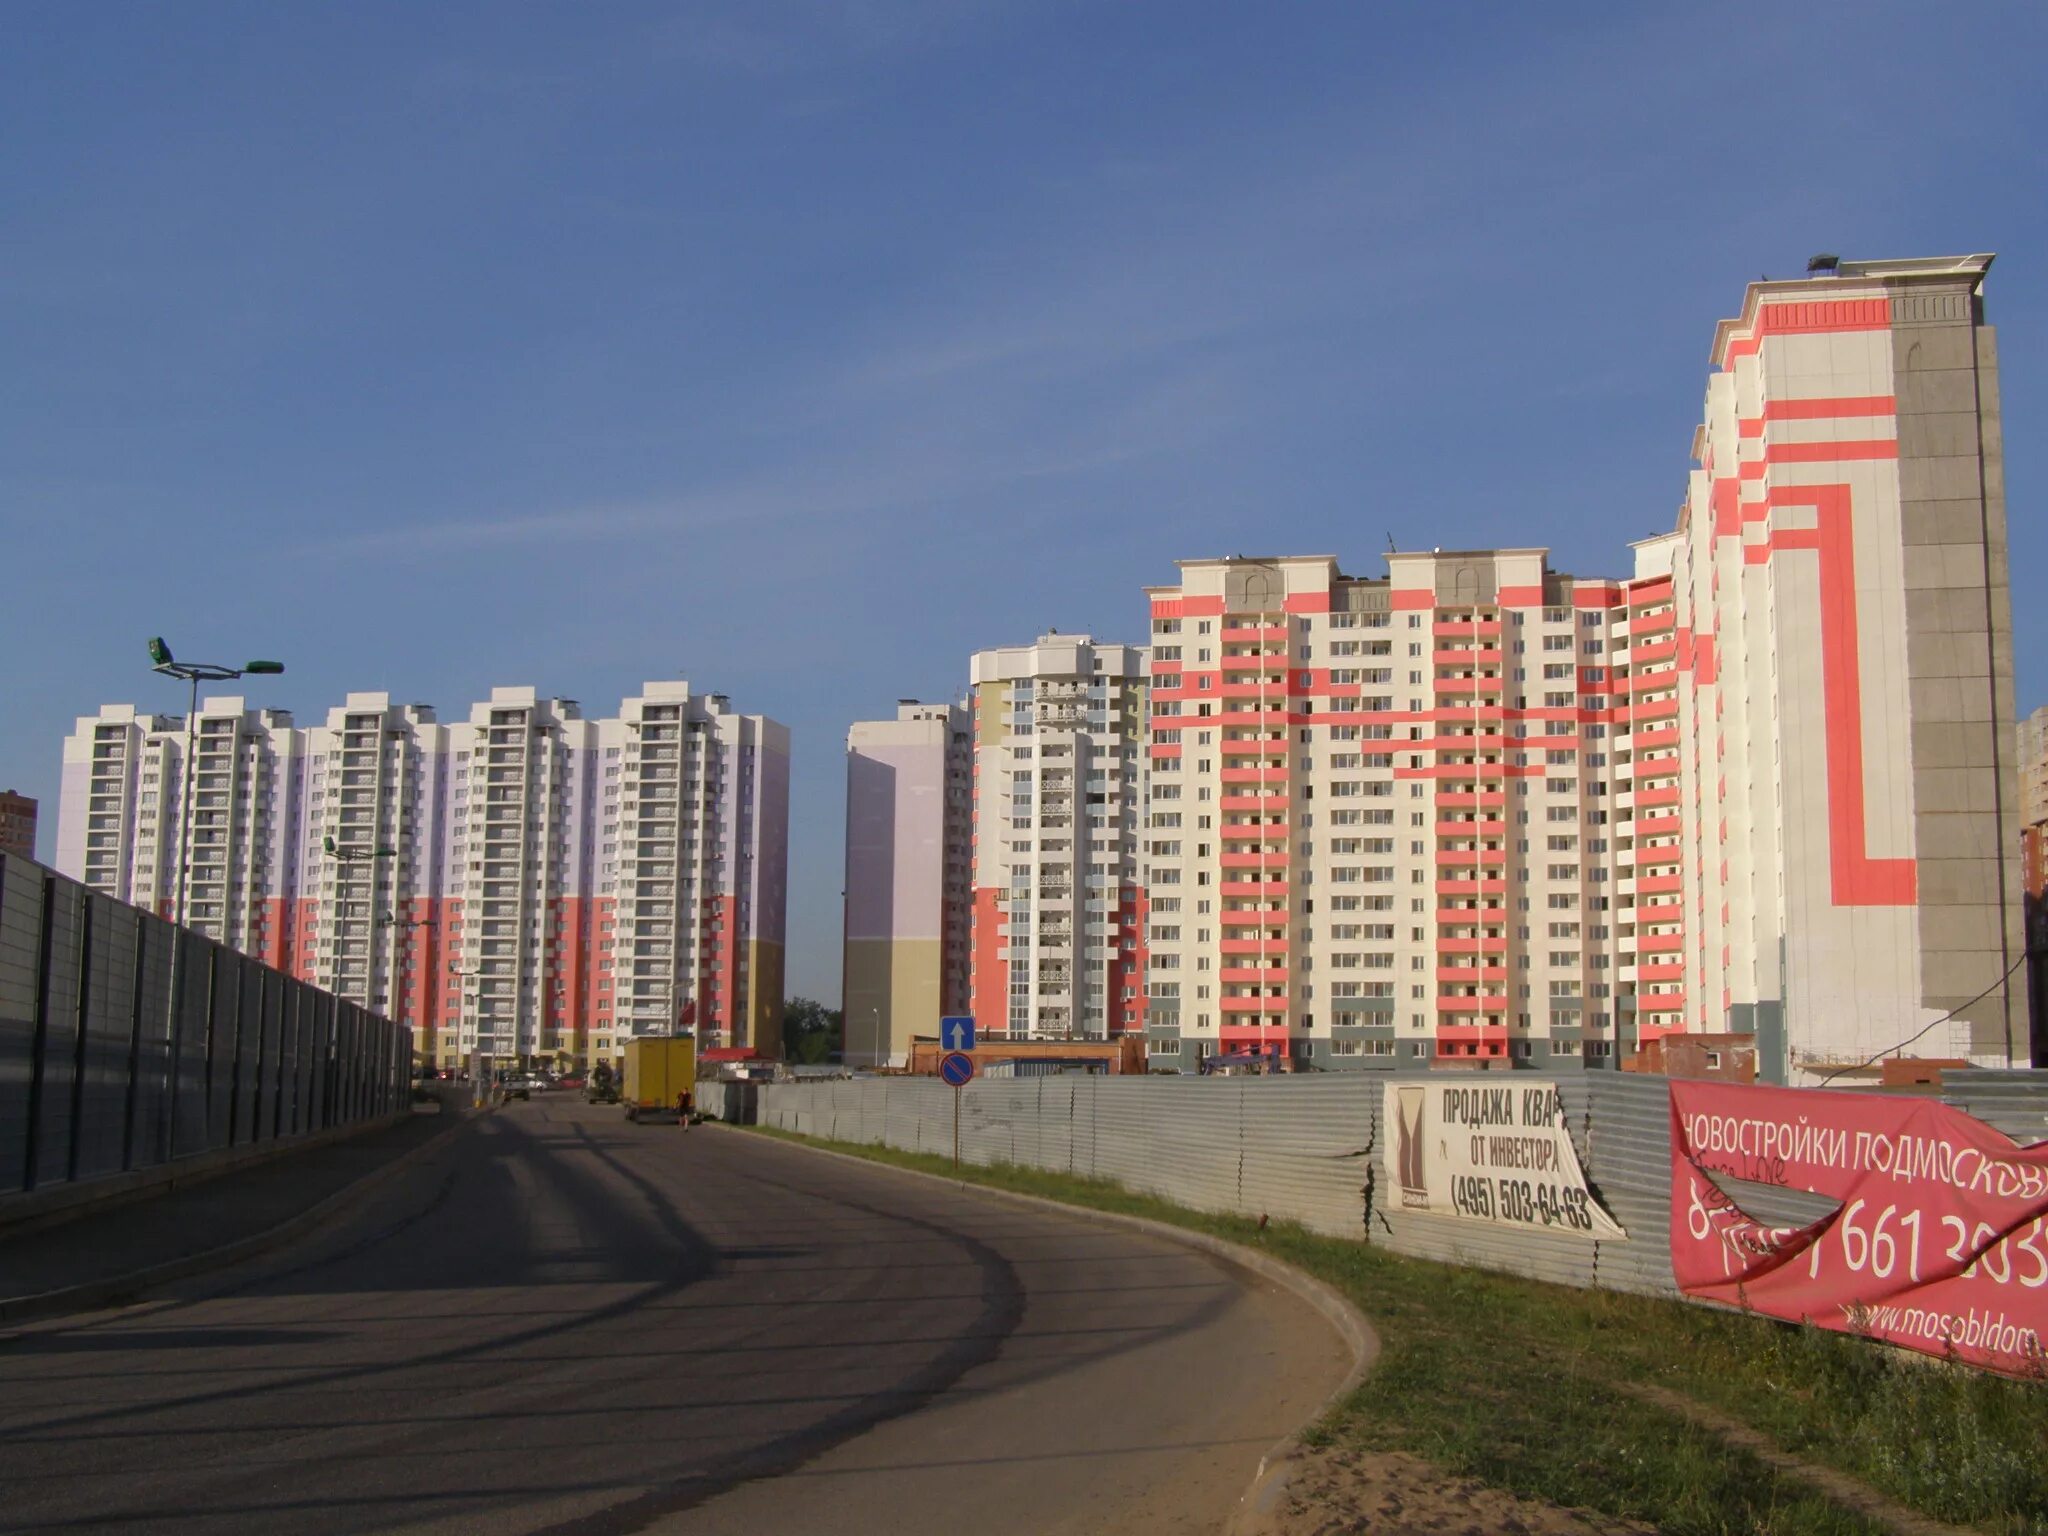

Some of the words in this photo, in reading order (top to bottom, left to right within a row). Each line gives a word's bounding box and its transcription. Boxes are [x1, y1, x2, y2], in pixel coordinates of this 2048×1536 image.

[1443, 1088, 1513, 1129] ПРОДАЖА
[1470, 1135, 1485, 1166] ОТ
[1490, 1136, 1560, 1172] ИНВЕСТОРА
[1682, 1113, 1847, 1169] НОВОСТРОЙКИ
[1853, 1131, 2048, 1199] ПОДМОСКОВ
[1451, 1174, 1497, 1220] (495)
[1499, 1179, 1593, 1230] 503-64-63
